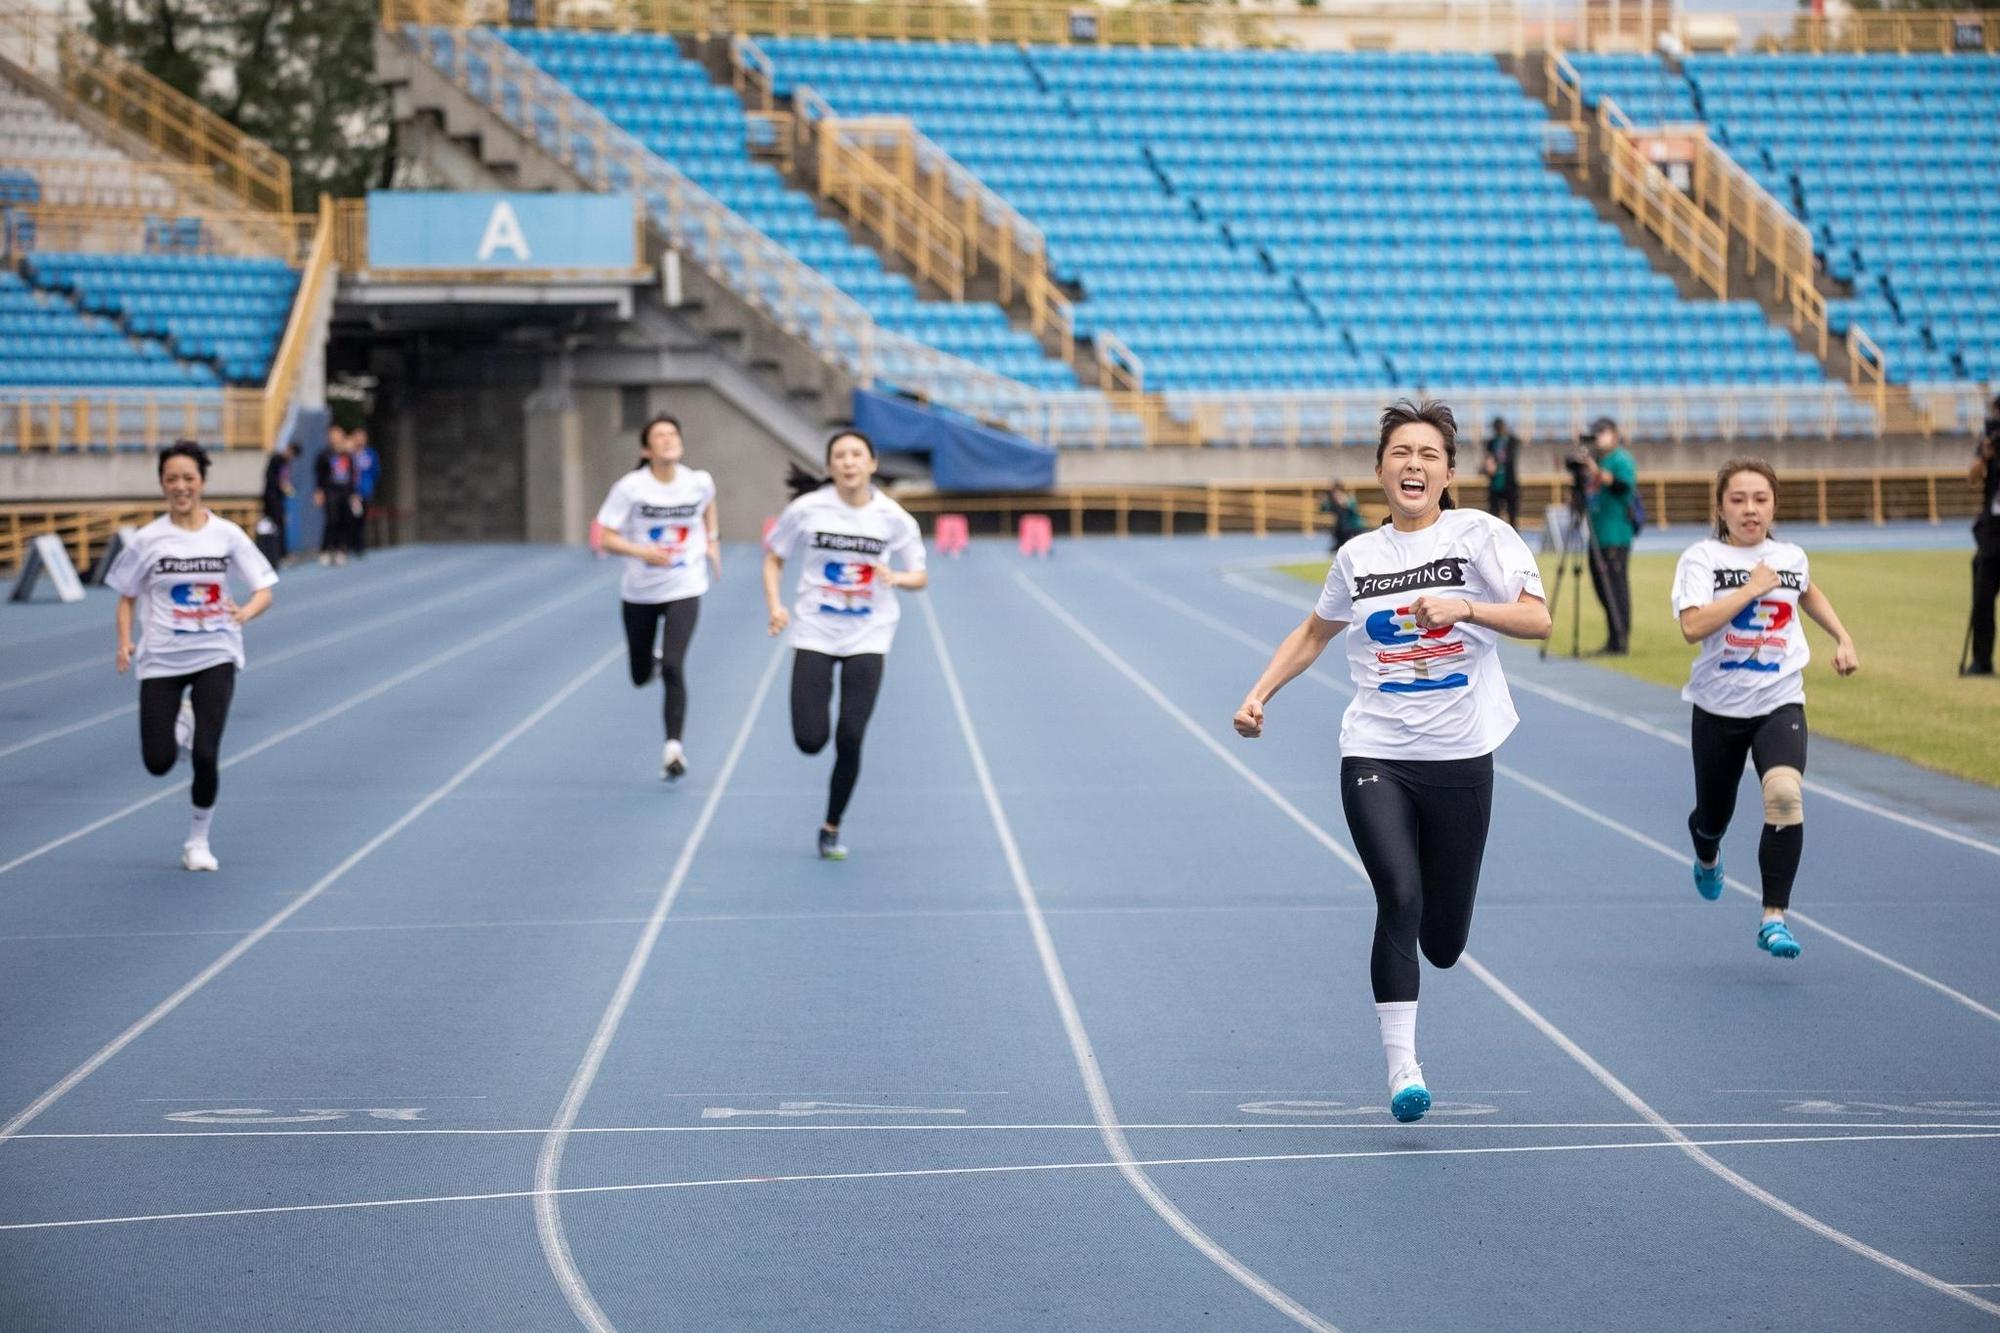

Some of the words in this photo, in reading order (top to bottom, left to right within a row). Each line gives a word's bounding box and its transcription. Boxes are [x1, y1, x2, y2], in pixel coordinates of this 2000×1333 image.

[478, 202, 531, 261] A
[1361, 565, 1453, 594] FIGHTING
[1724, 571, 1797, 587] FIGNG
